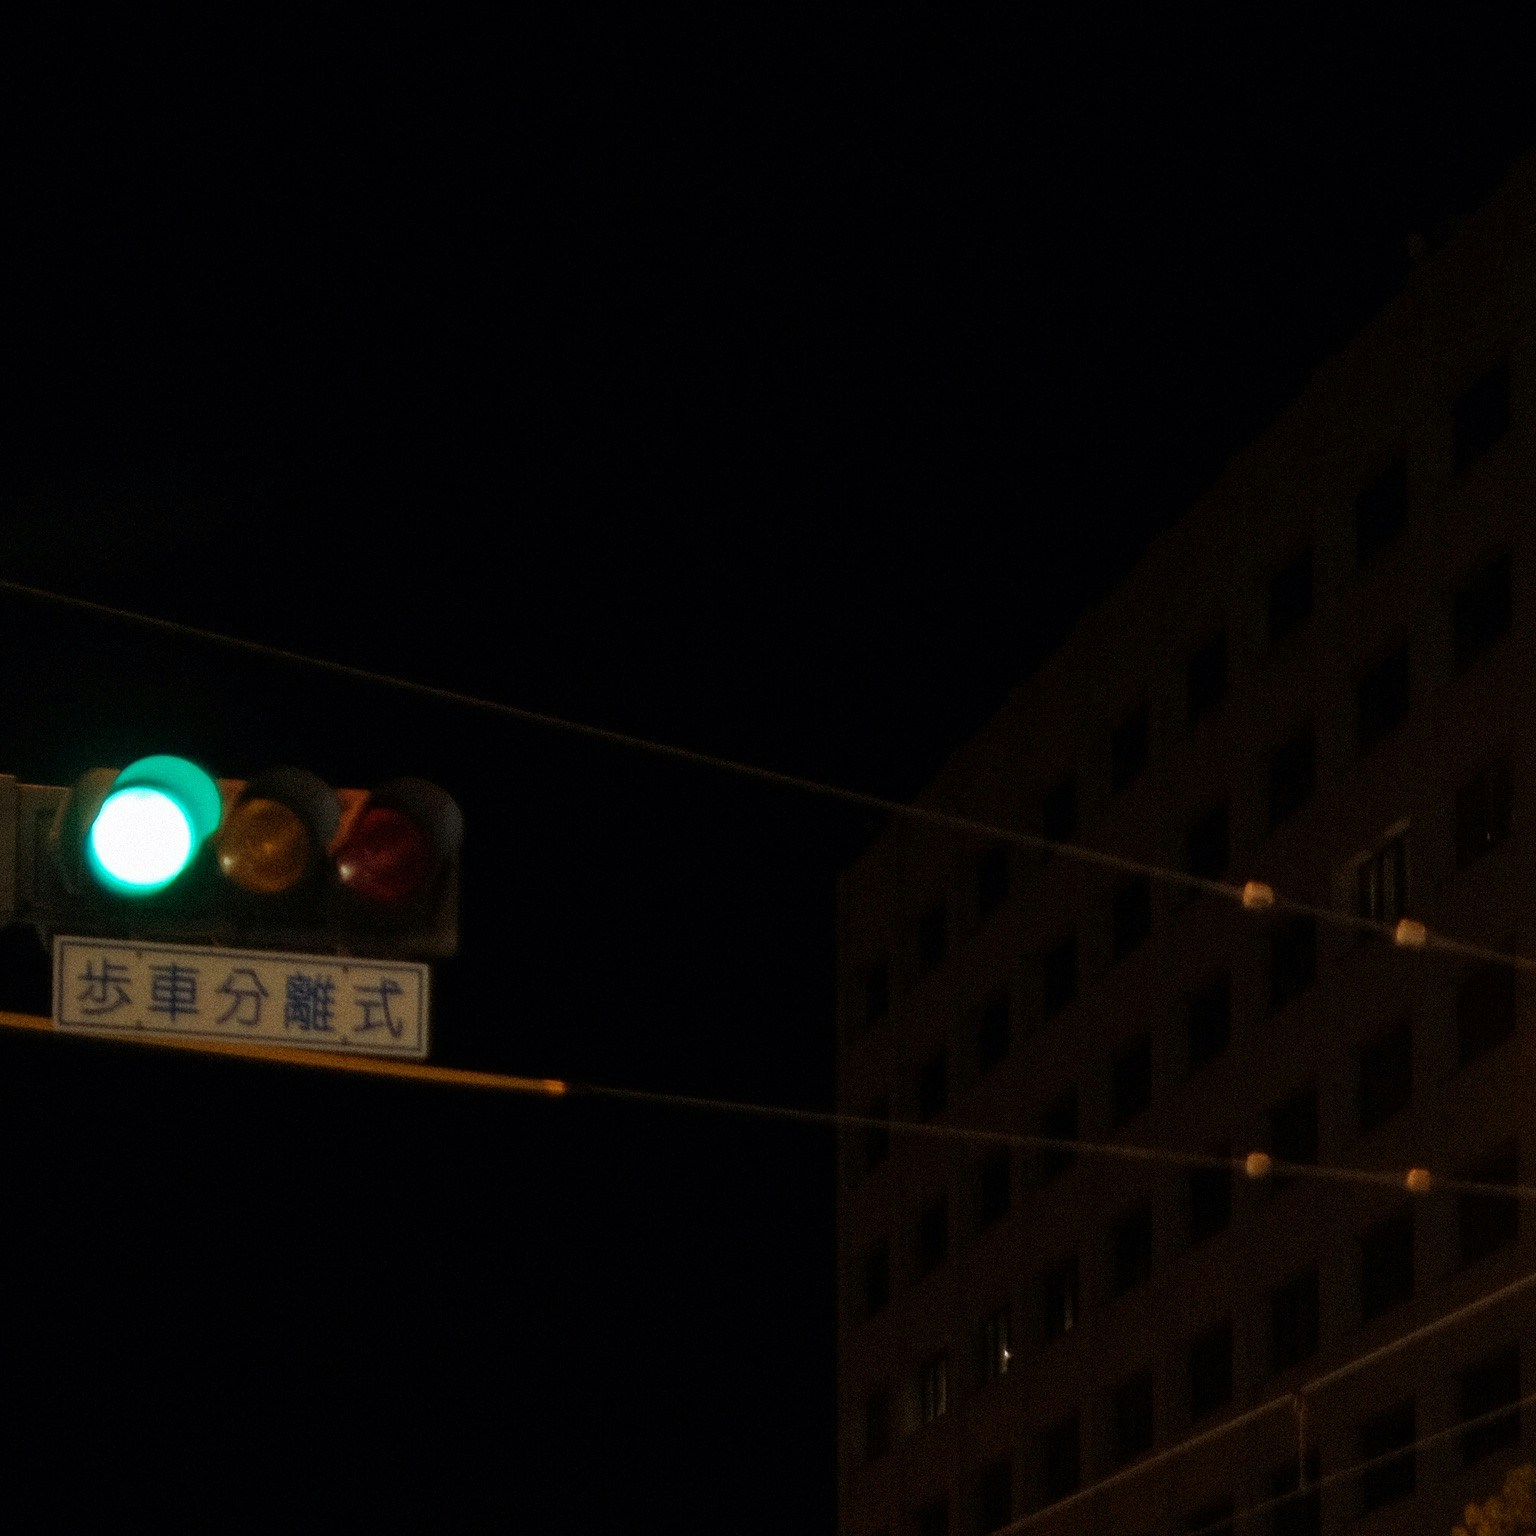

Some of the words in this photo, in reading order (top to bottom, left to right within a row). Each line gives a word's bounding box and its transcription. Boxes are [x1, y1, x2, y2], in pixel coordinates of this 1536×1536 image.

[77, 959, 403, 1038] 歩車分離式
